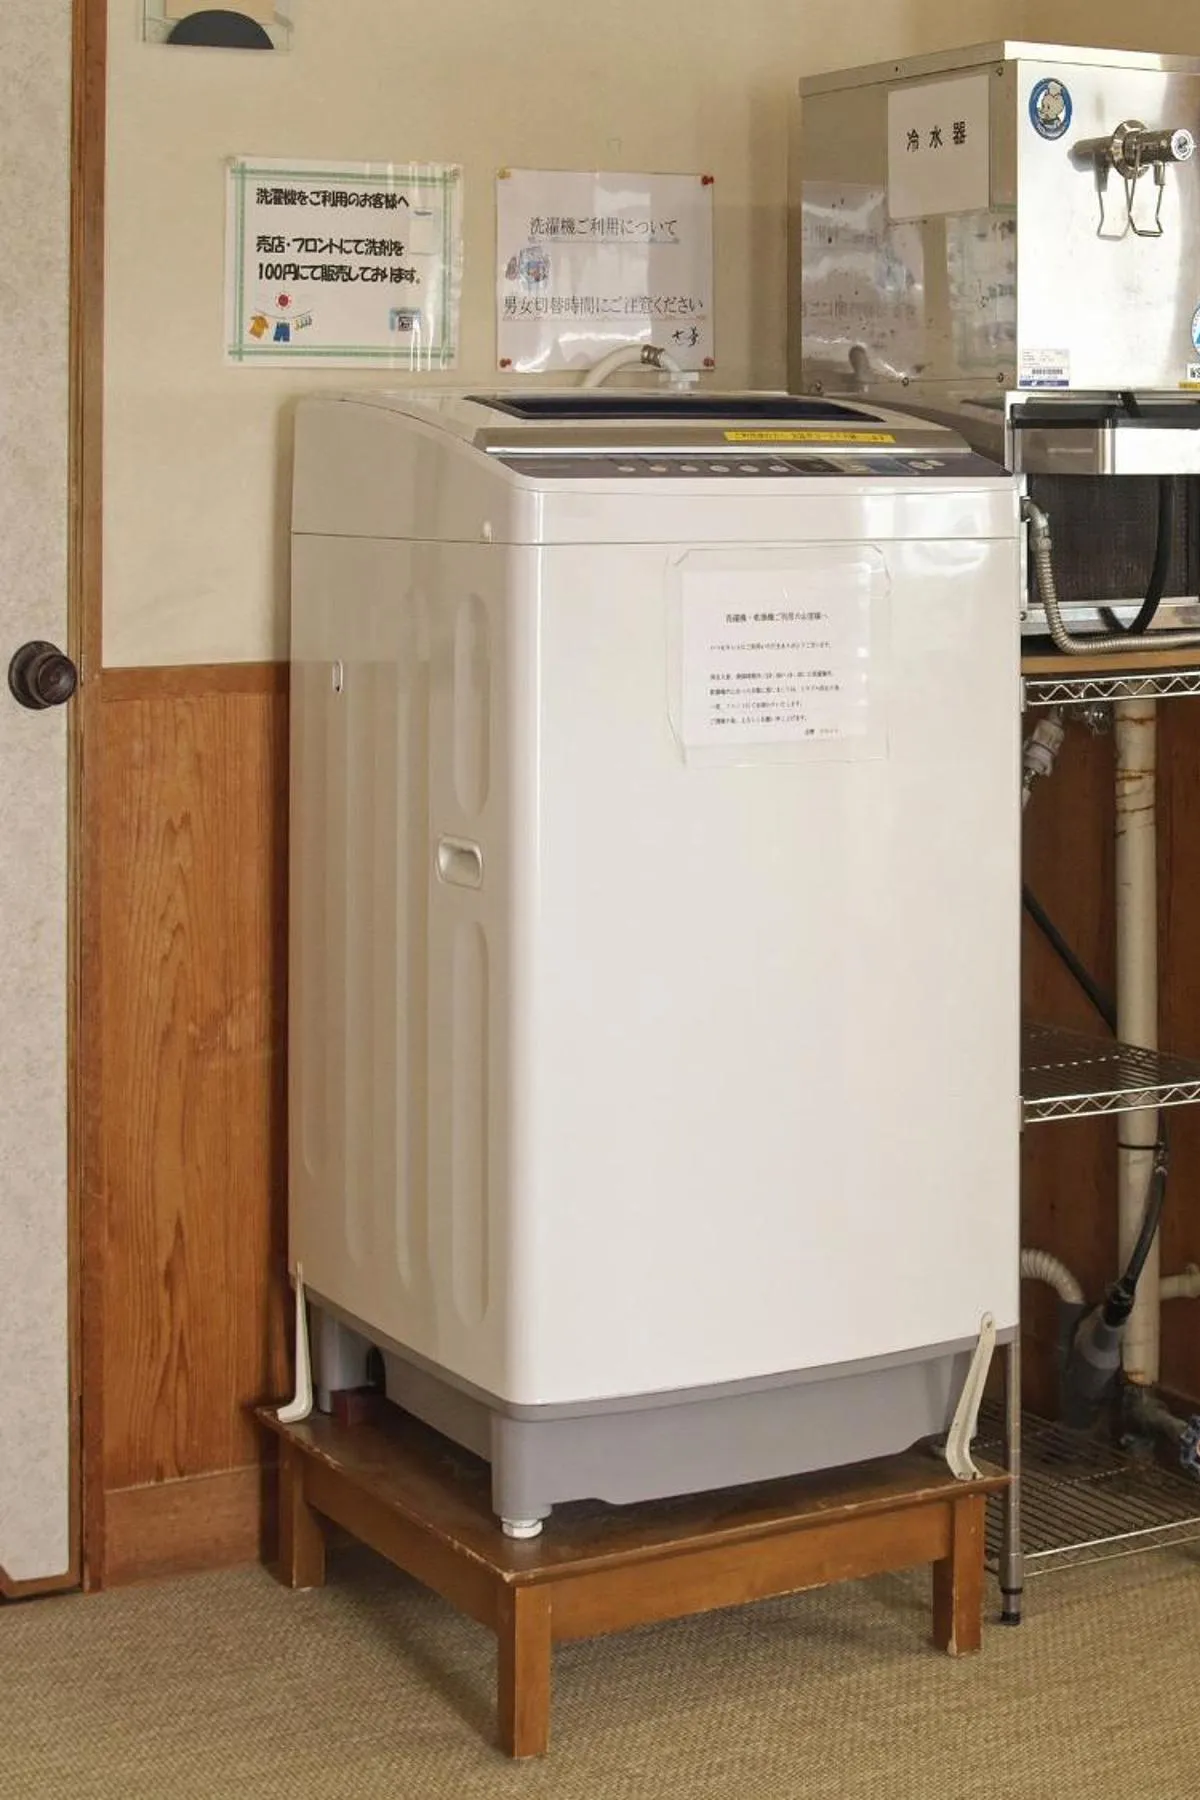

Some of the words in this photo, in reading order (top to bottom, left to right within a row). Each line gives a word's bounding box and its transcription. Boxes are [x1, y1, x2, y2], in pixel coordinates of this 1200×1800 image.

[906, 121, 967, 152] 冷水器
[256, 188, 410, 210] 洗濯機をご利用のお客様へ
[530, 216, 678, 236] 洗濯機ご利用について
[256, 235, 405, 257] 売店・フロントにて洗剤を
[504, 295, 704, 316] 男女切替時間にご注意ください
